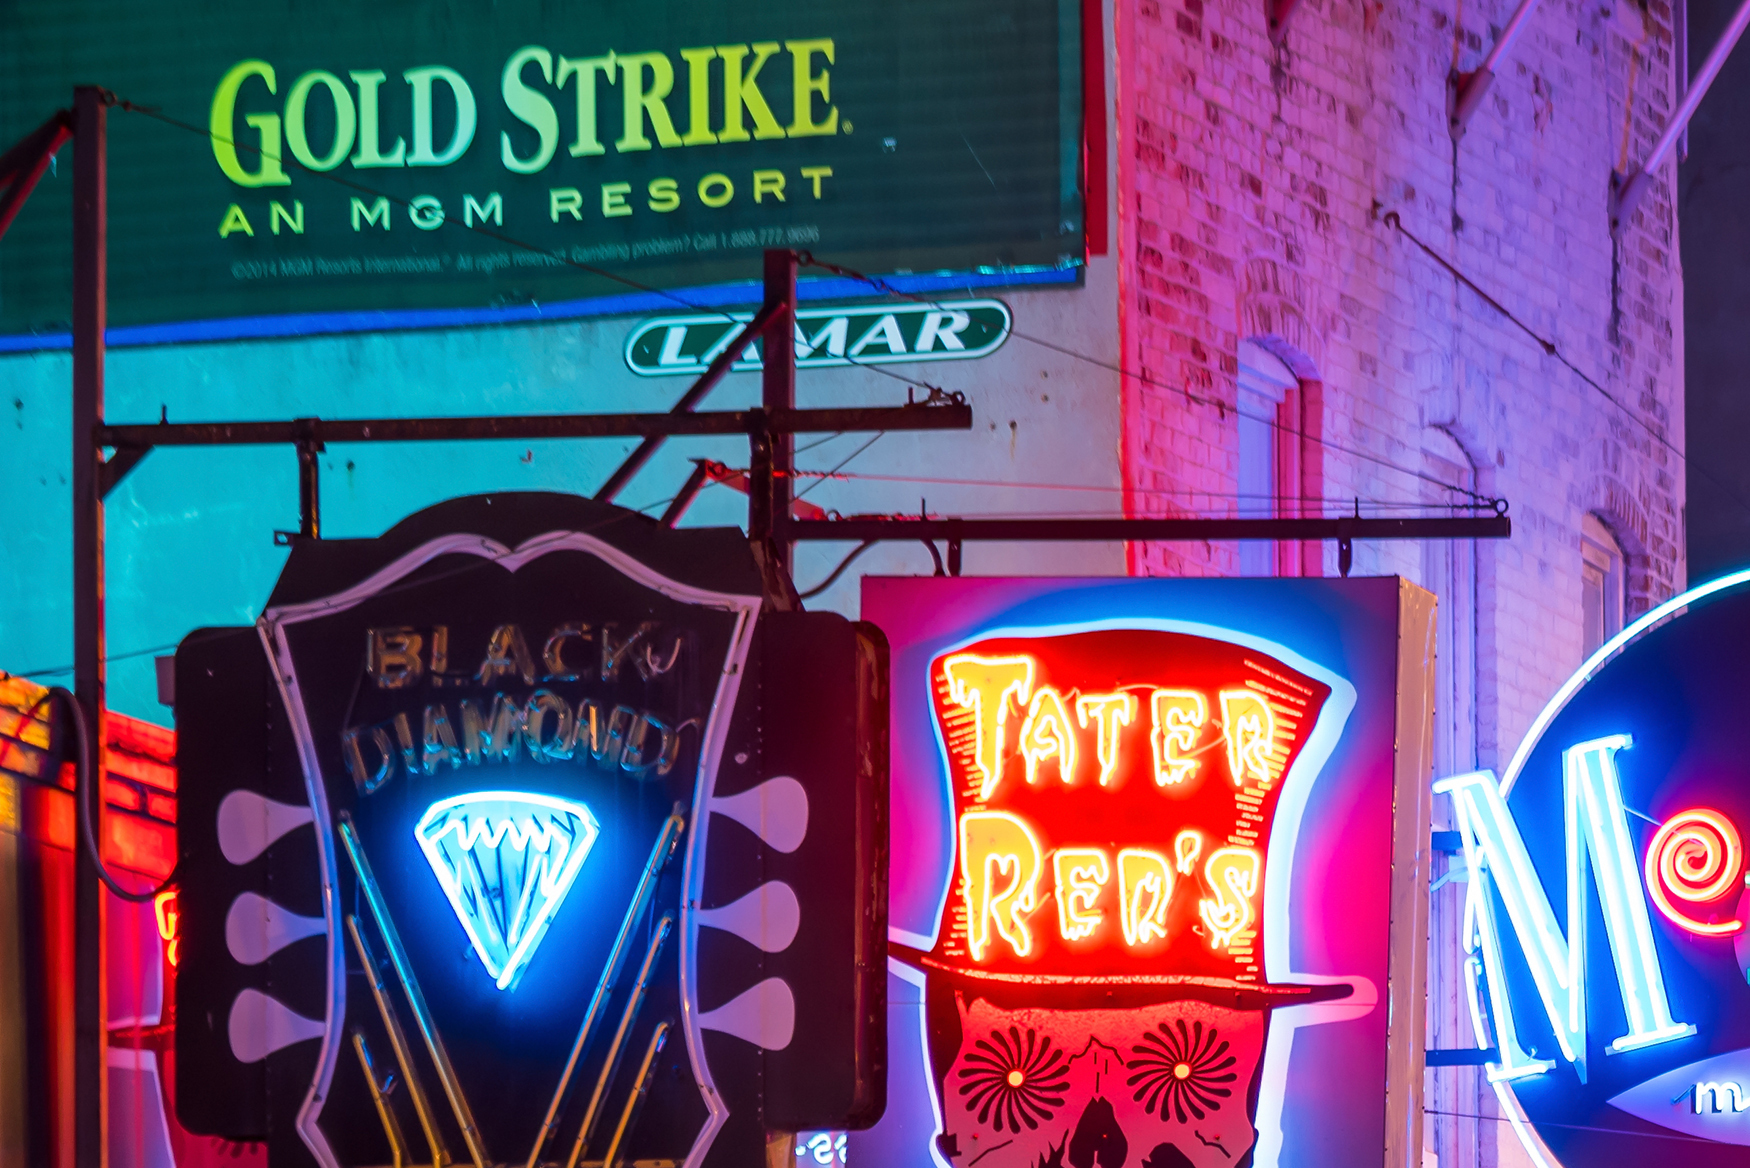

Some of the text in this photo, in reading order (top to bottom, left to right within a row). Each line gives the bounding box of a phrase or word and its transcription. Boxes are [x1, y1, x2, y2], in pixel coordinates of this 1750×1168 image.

[211, 38, 841, 188] GOLD STRIKE
[220, 166, 836, 239] AN MGM RESORT
[658, 309, 972, 367] LAMAR
[366, 622, 664, 689] BLACK
[342, 689, 682, 797] DIAMOND
[943, 653, 1278, 799] TATER
[959, 812, 1263, 962] RED'S
